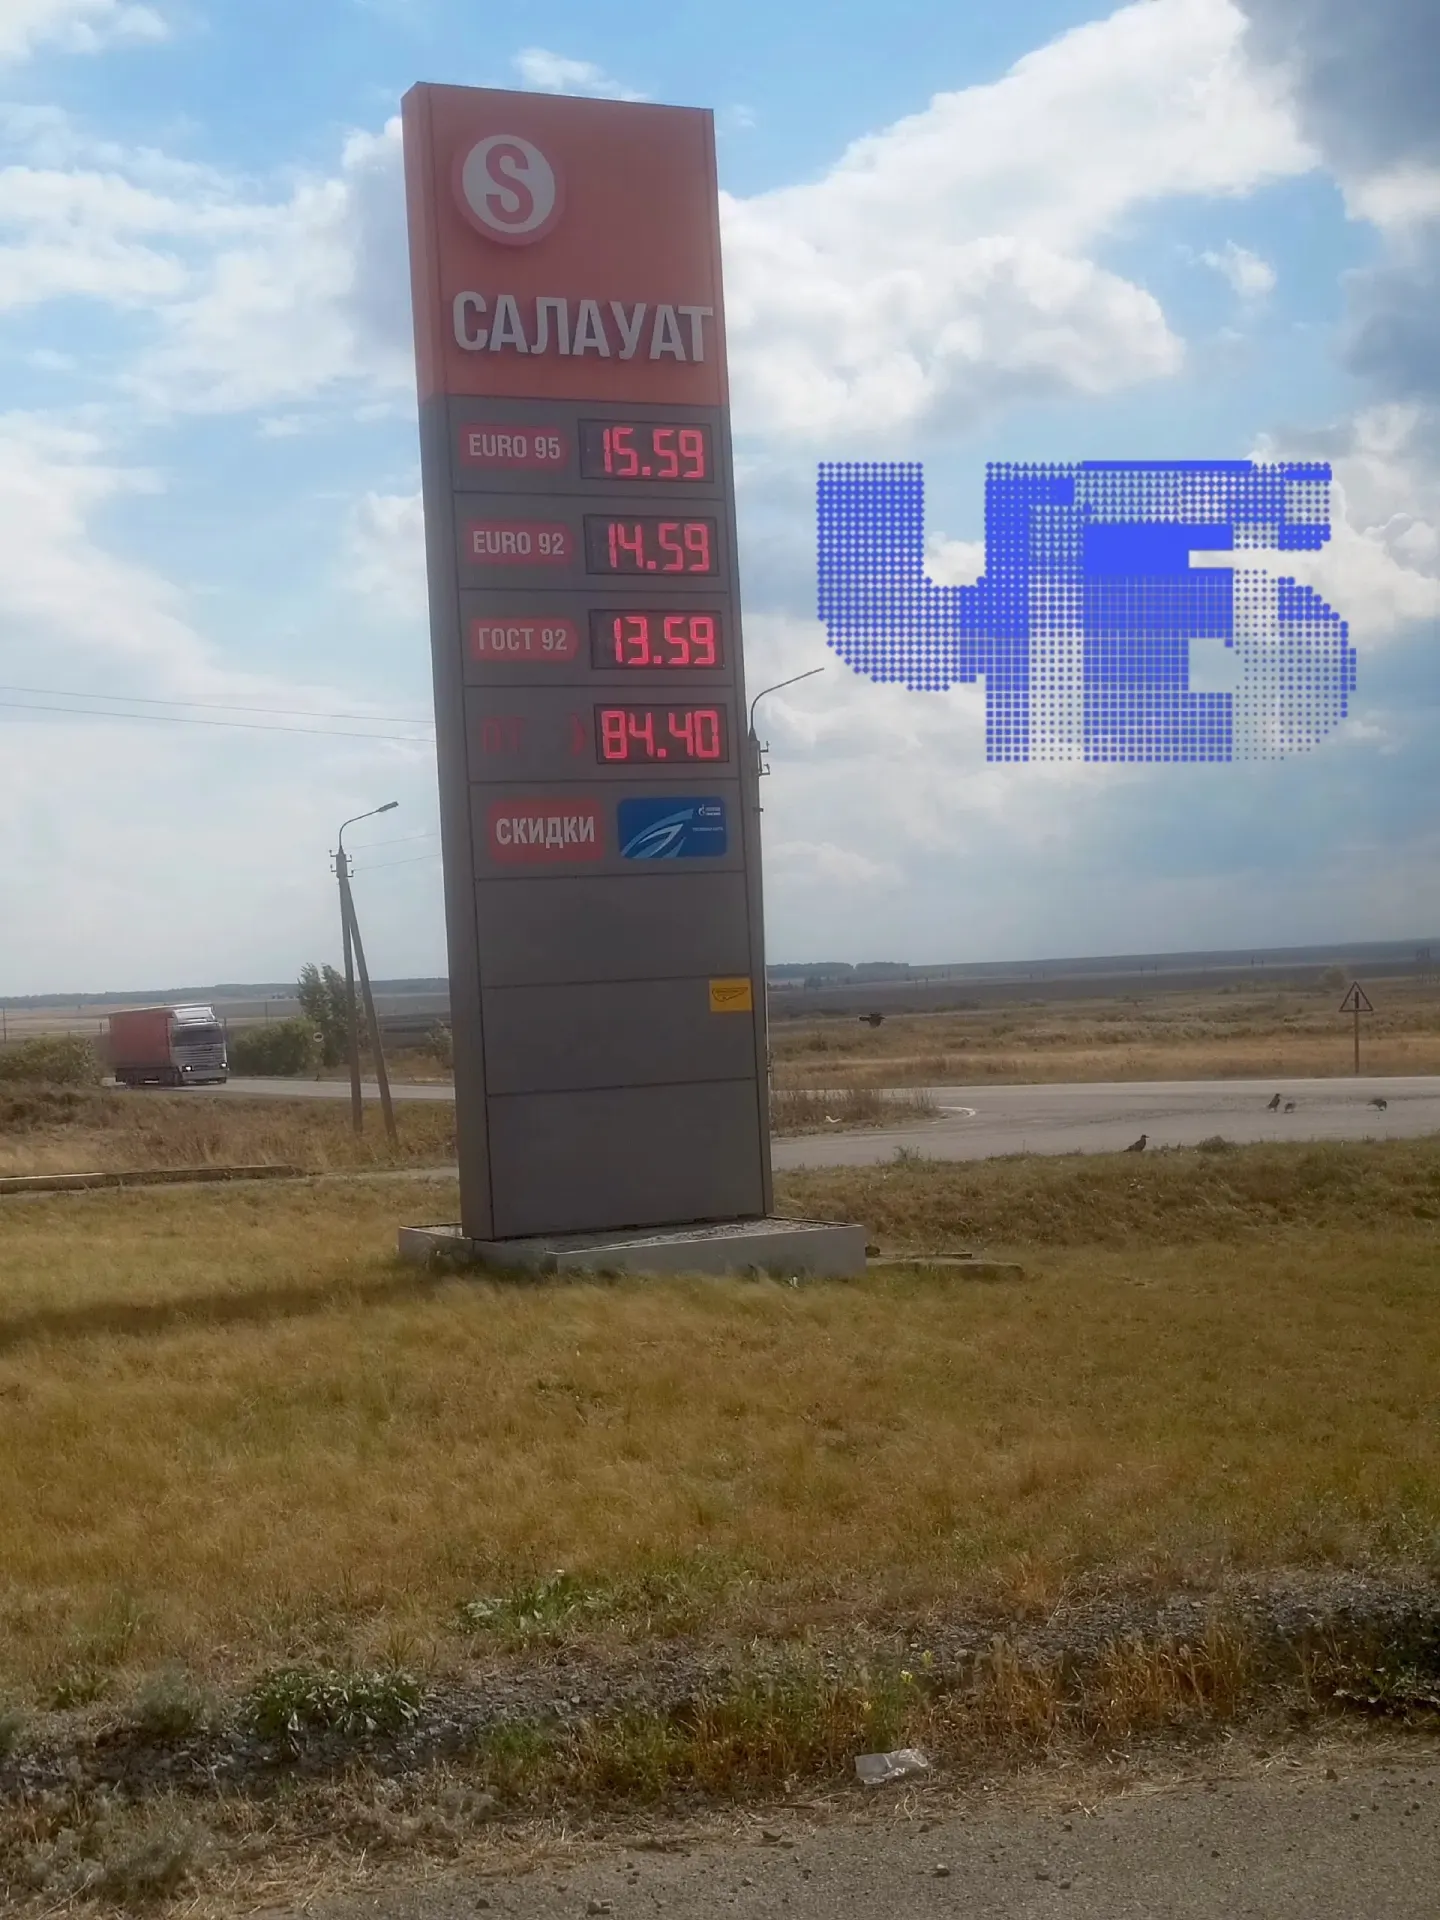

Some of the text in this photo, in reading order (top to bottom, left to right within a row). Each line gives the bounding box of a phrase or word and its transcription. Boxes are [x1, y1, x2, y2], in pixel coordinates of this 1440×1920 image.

[452, 290, 714, 364] САЛАУАТ
[468, 433, 562, 460] EURO 95
[602, 426, 705, 479] 15.59
[472, 530, 565, 556] EURO 92
[607, 523, 711, 572] 14.59
[478, 627, 568, 651] ГОСТ 92
[613, 616, 716, 665] 13.59
[601, 709, 721, 760] 84.40
[495, 816, 596, 849] СКИДКИ
